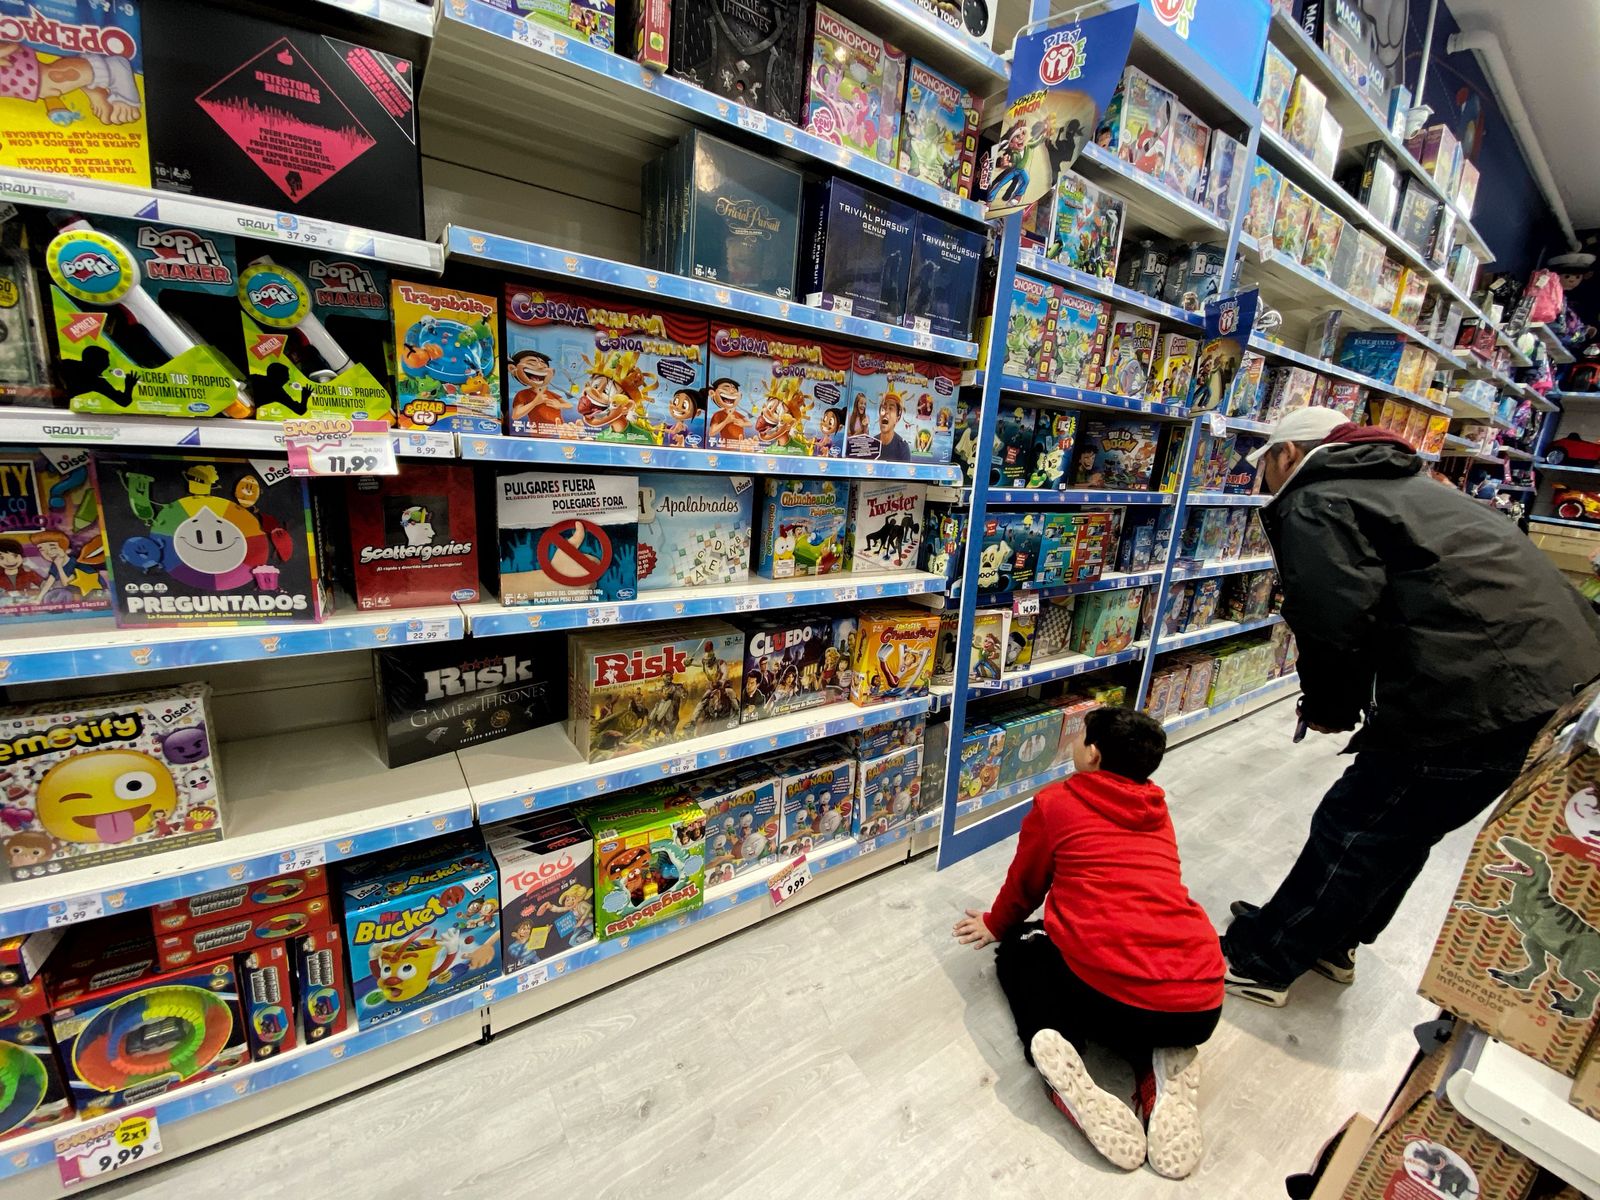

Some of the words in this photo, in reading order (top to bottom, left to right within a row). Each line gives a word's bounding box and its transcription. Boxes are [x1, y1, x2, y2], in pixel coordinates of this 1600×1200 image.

[940, 10, 960, 28] TODO
[518, 34, 543, 48] 22.99
[819, 18, 881, 59] MONOPOLY
[1044, 29, 1081, 52] Play
[255, 71, 311, 91] DETECTOR
[913, 70, 960, 102] MONOPOLY
[264, 82, 321, 104] MENTIRAS
[1012, 89, 1048, 106] SOMBRA
[8, 138, 33, 147] COM
[43, 138, 85, 147] MÉDICO
[86, 139, 100, 147] DE
[104, 139, 141, 148] CARTAS
[17, 157, 72, 167] CLÁSICAS!
[74, 158, 111, 166] PIEZAS
[89, 166, 137, 174] TARJETAS
[112, 158, 133, 166] LAS
[839, 202, 873, 223] TRIVIAL
[874, 216, 910, 236] PURSUIT
[286, 231, 318, 244] 37.99
[862, 222, 887, 236] GENUS
[141, 231, 194, 256] bop
[922, 233, 954, 251] TRIVIAL
[951, 244, 981, 260] PURSUIT
[148, 262, 231, 284] MAKER
[310, 261, 356, 285] bop
[1013, 278, 1044, 295] ONOPOLY
[317, 289, 384, 308] MAKER
[400, 285, 492, 317] Tragabolas
[1062, 296, 1095, 313] MONOPOLY
[511, 293, 590, 325] CORONA
[594, 331, 644, 352] COROA
[714, 328, 769, 357] CORONA
[140, 371, 169, 384] ¡CREA
[169, 372, 190, 385] TUS
[192, 375, 231, 388] PROPIOS
[138, 384, 207, 400] MOVIMIENTOS!
[313, 384, 337, 396] ¡CREA
[338, 386, 354, 396] TUS
[354, 387, 387, 399] PROPIOS
[311, 397, 367, 409] MOVIMIENTOS!
[413, 403, 444, 414] GRAB
[283, 420, 351, 437] CHOLLO
[316, 433, 348, 442] precio
[416, 446, 437, 456] 8.99
[328, 454, 379, 476] 11,99
[504, 480, 560, 496] PULGARES
[562, 478, 596, 493] FUERA
[552, 497, 600, 511] POLEGARES
[602, 495, 624, 507] FORA
[656, 496, 739, 517] Apalabrados
[867, 494, 918, 518] Twister
[360, 540, 473, 564] Scattergories
[127, 594, 308, 614] PREGUNTADOS
[591, 617, 610, 625] 25.99
[413, 631, 437, 640] 22.99
[749, 626, 813, 658] CLUEDO
[594, 645, 688, 687] Risk
[161, 701, 194, 725] Diset
[410, 702, 466, 728] GAME
[476, 686, 546, 712] THRONES
[285, 859, 312, 871] 27.99
[504, 851, 577, 892] Tabú
[471, 874, 495, 894] Diset
[787, 877, 806, 895] 9,99
[55, 912, 87, 924] 24.99
[606, 884, 699, 936] Tragabolas
[1436, 974, 1505, 1013] infrarrojos
[1440, 965, 1518, 1008] Velociraptor
[120, 1130, 148, 1144] 2x1
[98, 1144, 145, 1172] 9,99
